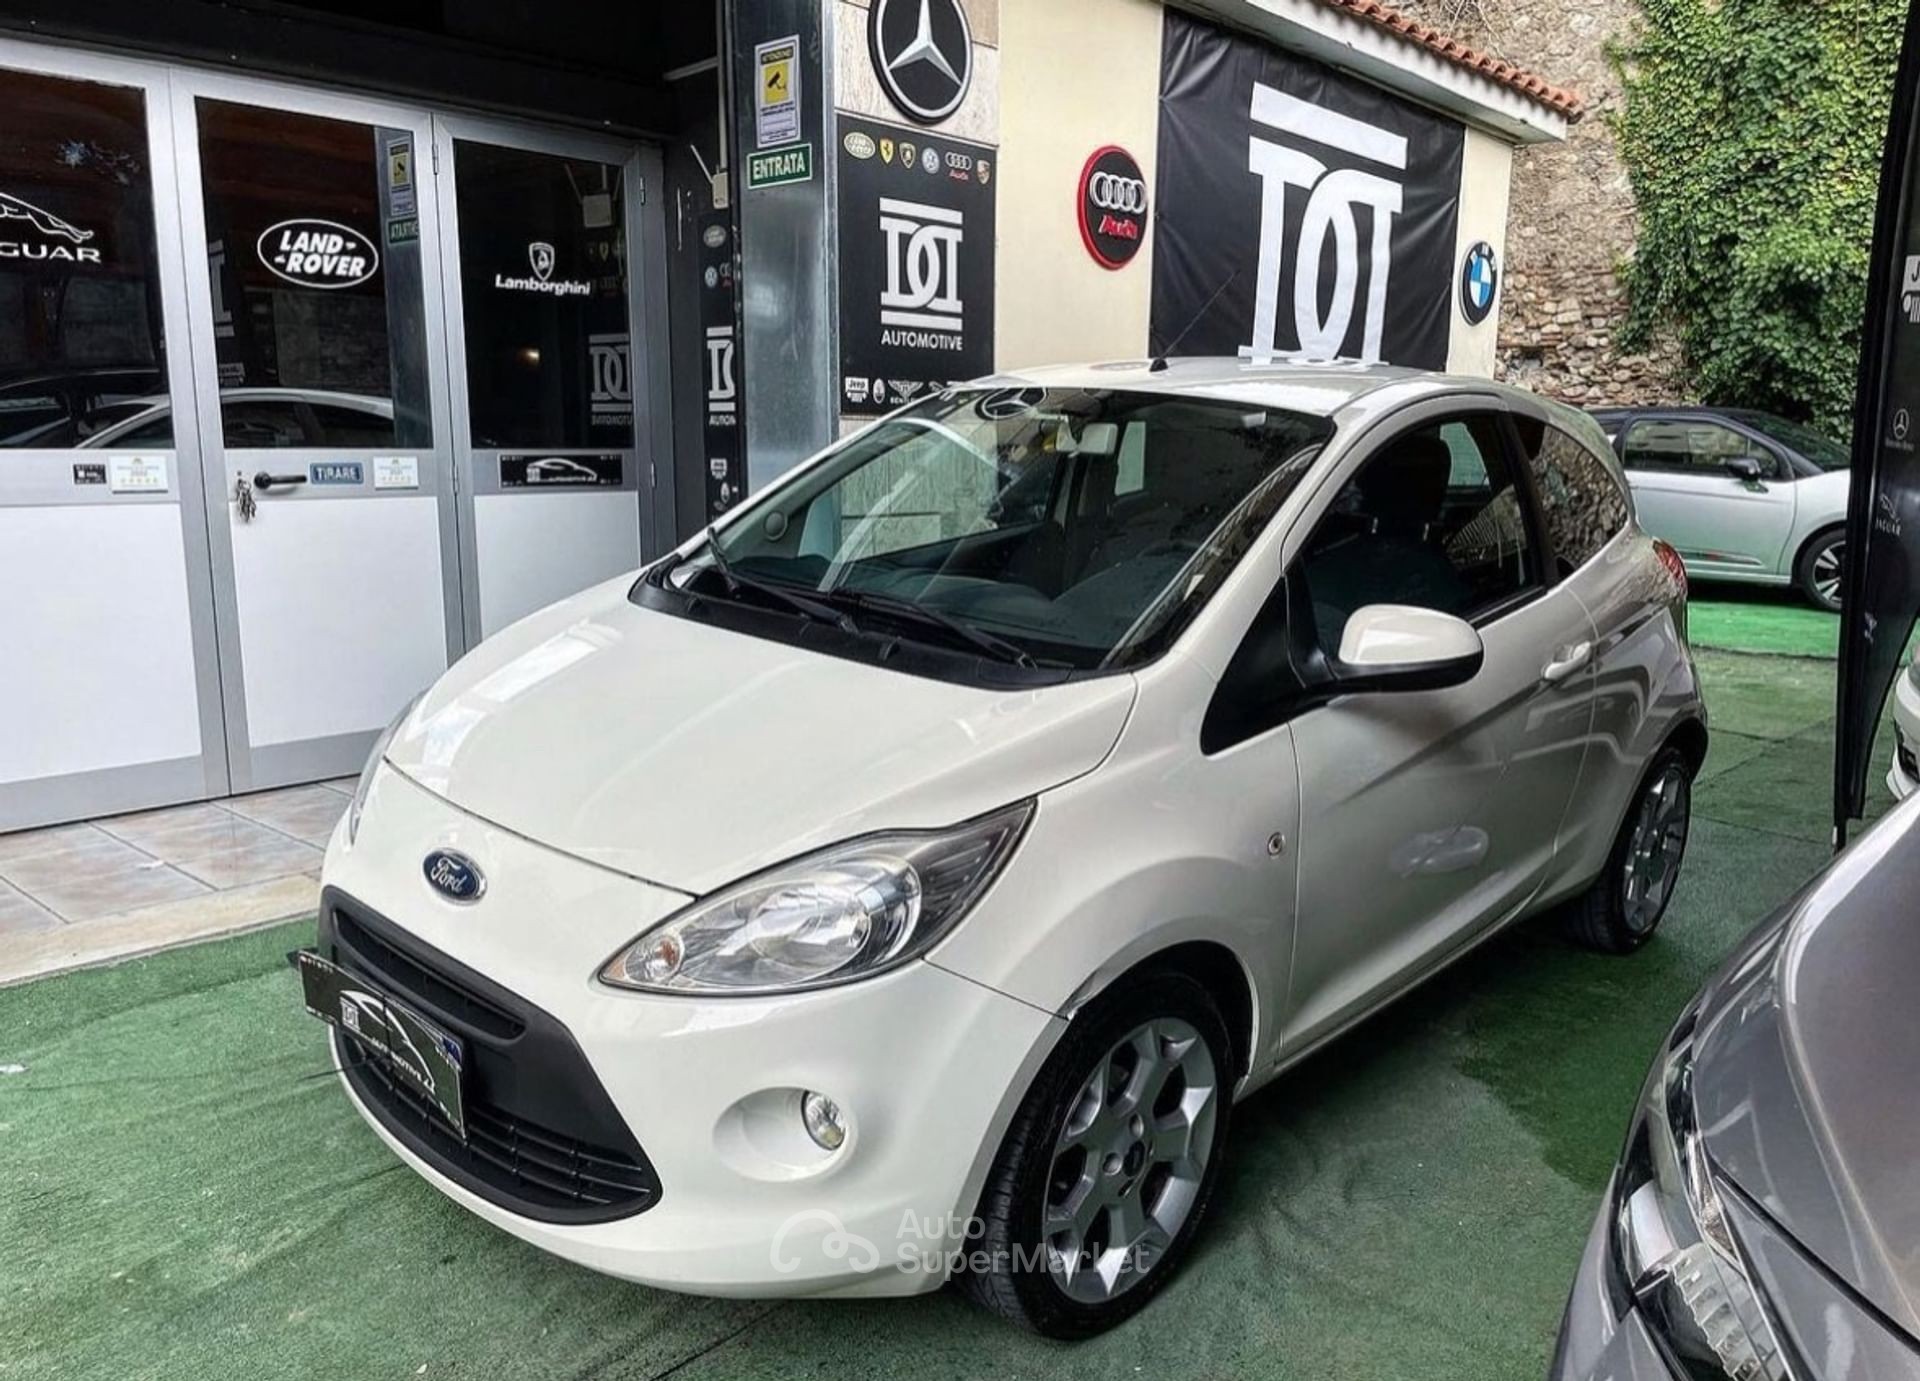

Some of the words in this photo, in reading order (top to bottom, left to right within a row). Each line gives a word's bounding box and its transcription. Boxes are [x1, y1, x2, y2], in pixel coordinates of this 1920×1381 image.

[753, 152, 806, 180] ENTRATA
[1098, 214, 1138, 240] Audi
[0, 242, 101, 263] GUAR
[285, 252, 366, 277] ROVER
[495, 274, 590, 296] Lamborghini
[881, 329, 963, 351] AUTOMOTIVE
[316, 466, 358, 481] TIRARE
[431, 856, 468, 893] Ford
